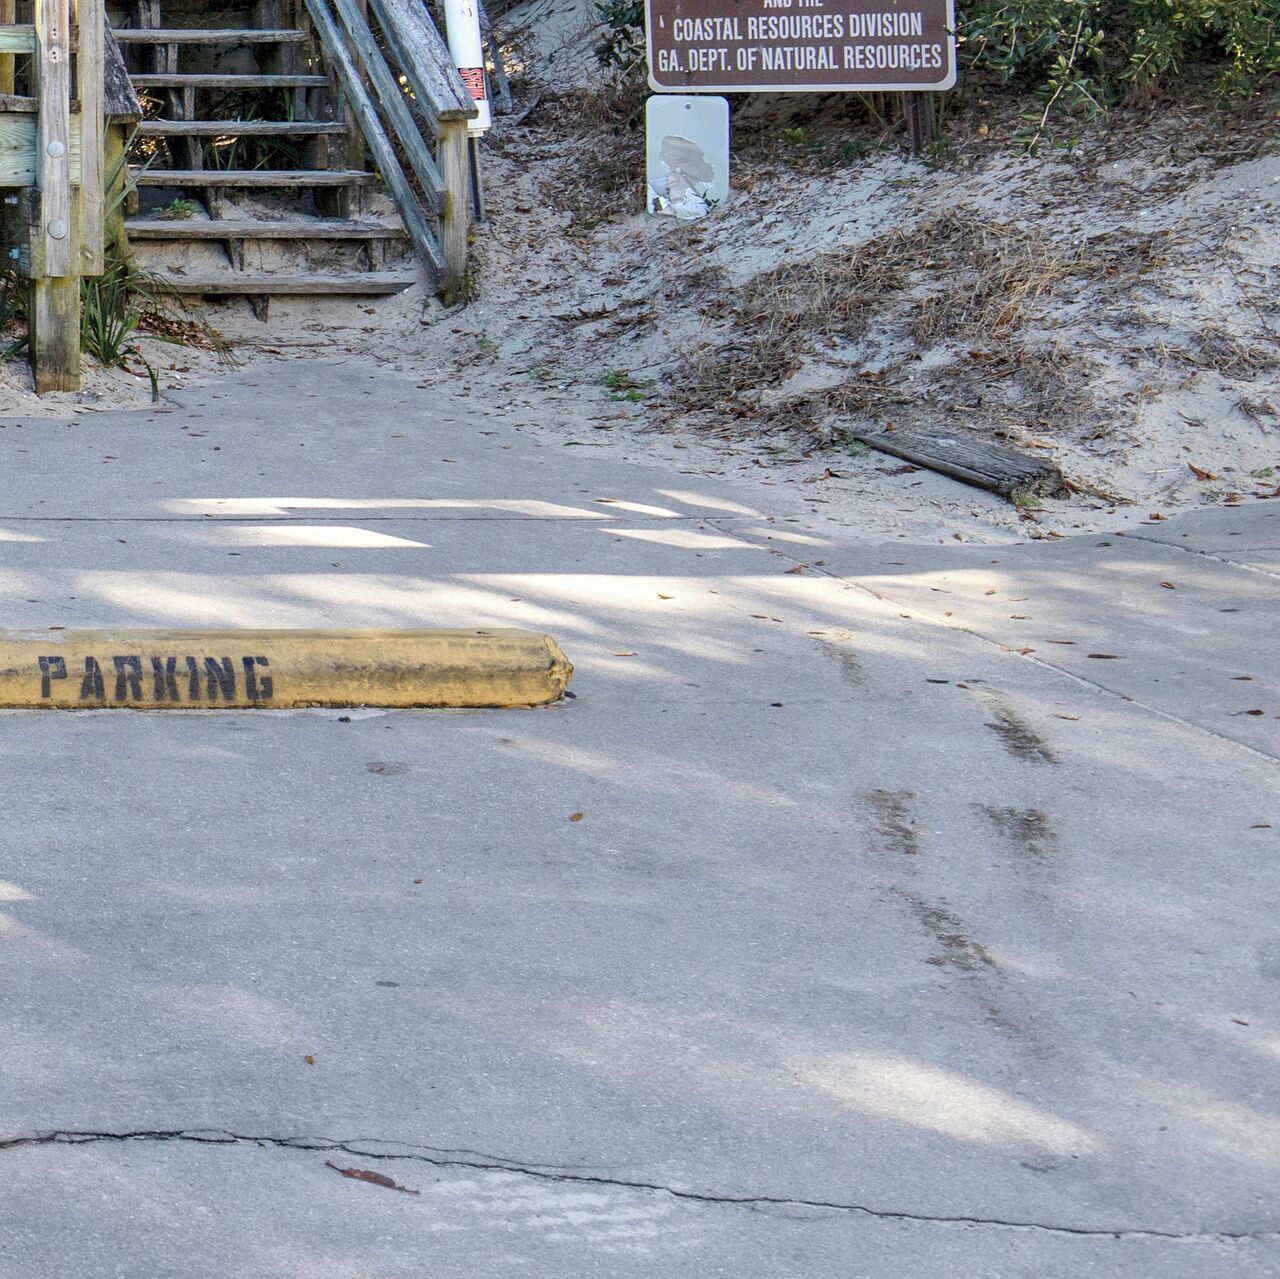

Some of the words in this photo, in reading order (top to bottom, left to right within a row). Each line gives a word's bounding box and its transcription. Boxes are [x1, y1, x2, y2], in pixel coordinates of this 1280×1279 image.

[673, 17, 742, 42] COASTAL
[747, 14, 844, 40] RESOURCES
[849, 12, 923, 38] DIVISION
[658, 49, 684, 73] GA.
[689, 48, 732, 72] DEPT.
[737, 47, 759, 70] OF
[761, 46, 839, 71] NATURAL
[843, 44, 942, 70] RESOURCES
[38, 655, 274, 702] PARKING
